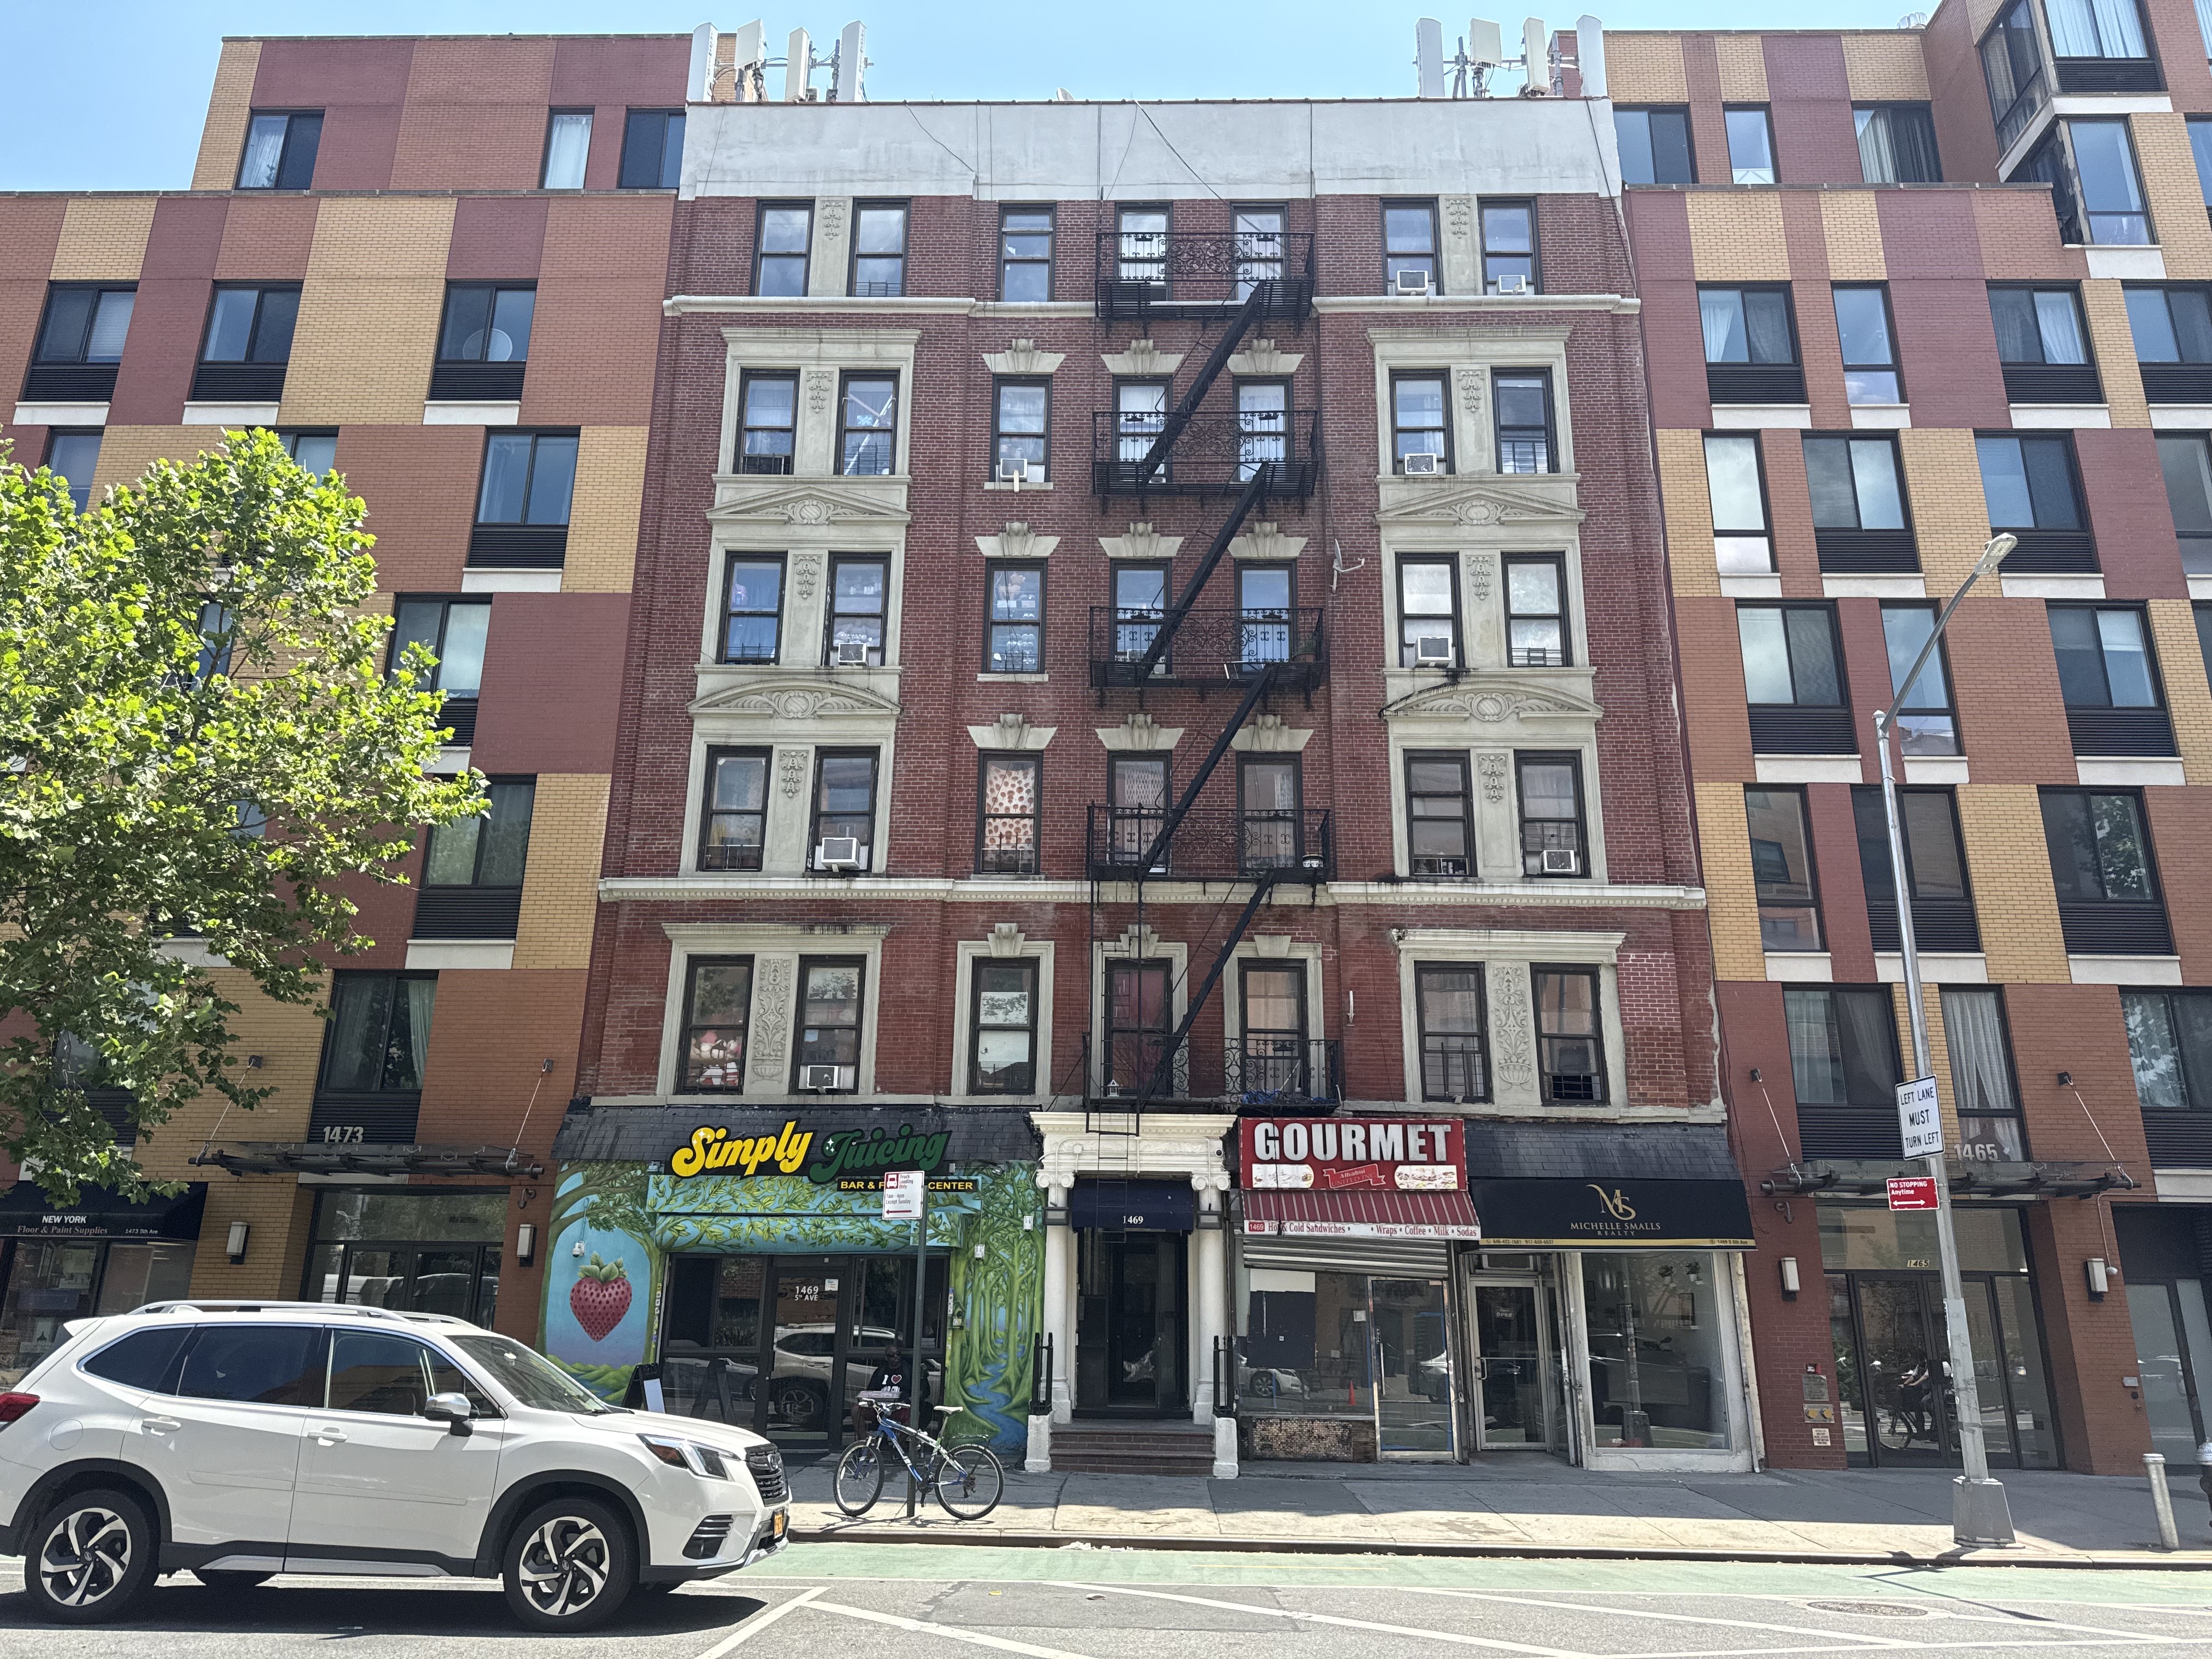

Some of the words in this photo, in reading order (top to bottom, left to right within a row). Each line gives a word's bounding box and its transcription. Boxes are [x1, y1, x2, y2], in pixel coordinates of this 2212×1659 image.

[1900, 1091, 1915, 1105] LEFT
[1917, 1086, 1934, 1101] LANE
[1909, 1109, 1929, 1127] MUST
[323, 1126, 364, 1143] 1473
[1254, 1122, 1452, 1161] GOURMET
[1905, 1135, 1922, 1149] TURN
[1923, 1131, 1939, 1146] LEFT
[672, 1120, 814, 1177] Simply
[809, 1125, 952, 1183] Juicing
[1954, 1143, 1999, 1162] 1465
[928, 1182, 973, 1190] CENTER
[1331, 1176, 1360, 1187] UNITED
[42, 1215, 62, 1224] NEW
[64, 1215, 87, 1224] YORK
[1122, 1215, 1144, 1224] 1469
[17, 1225, 39, 1234] Floor
[50, 1226, 72, 1234] Paint
[74, 1226, 108, 1235] Supplies
[1268, 1222, 1280, 1232] Ho
[1282, 1222, 1288, 1232] &
[1289, 1222, 1305, 1232] Cold
[1306, 1223, 1346, 1234] Sandwiches
[1375, 1224, 1397, 1236] Wraps
[1404, 1225, 1426, 1235] Coffee
[1434, 1226, 1449, 1236] Milk
[1457, 1227, 1477, 1237] Sodas
[795, 1286, 819, 1294] 1469
[882, 1374, 889, 1385] I
